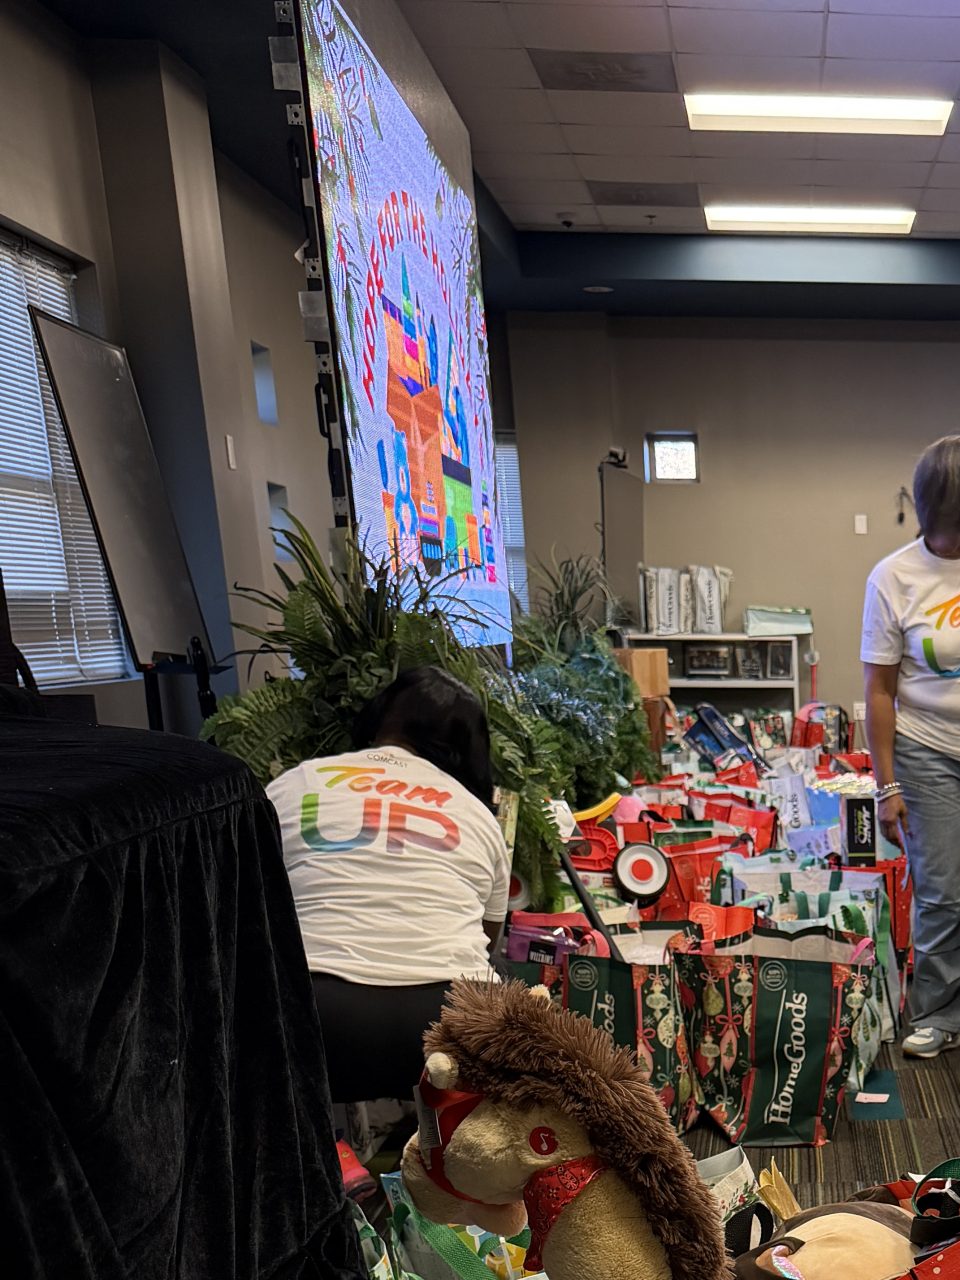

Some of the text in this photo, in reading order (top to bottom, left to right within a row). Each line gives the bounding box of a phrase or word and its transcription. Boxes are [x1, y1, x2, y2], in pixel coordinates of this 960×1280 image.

[377, 191, 404, 270] FOR
[400, 190, 429, 260] THE
[316, 766, 453, 808] Team
[367, 753, 409, 768] COMCAST
[300, 793, 461, 855] UP
[768, 991, 808, 1126] HomeGoods
